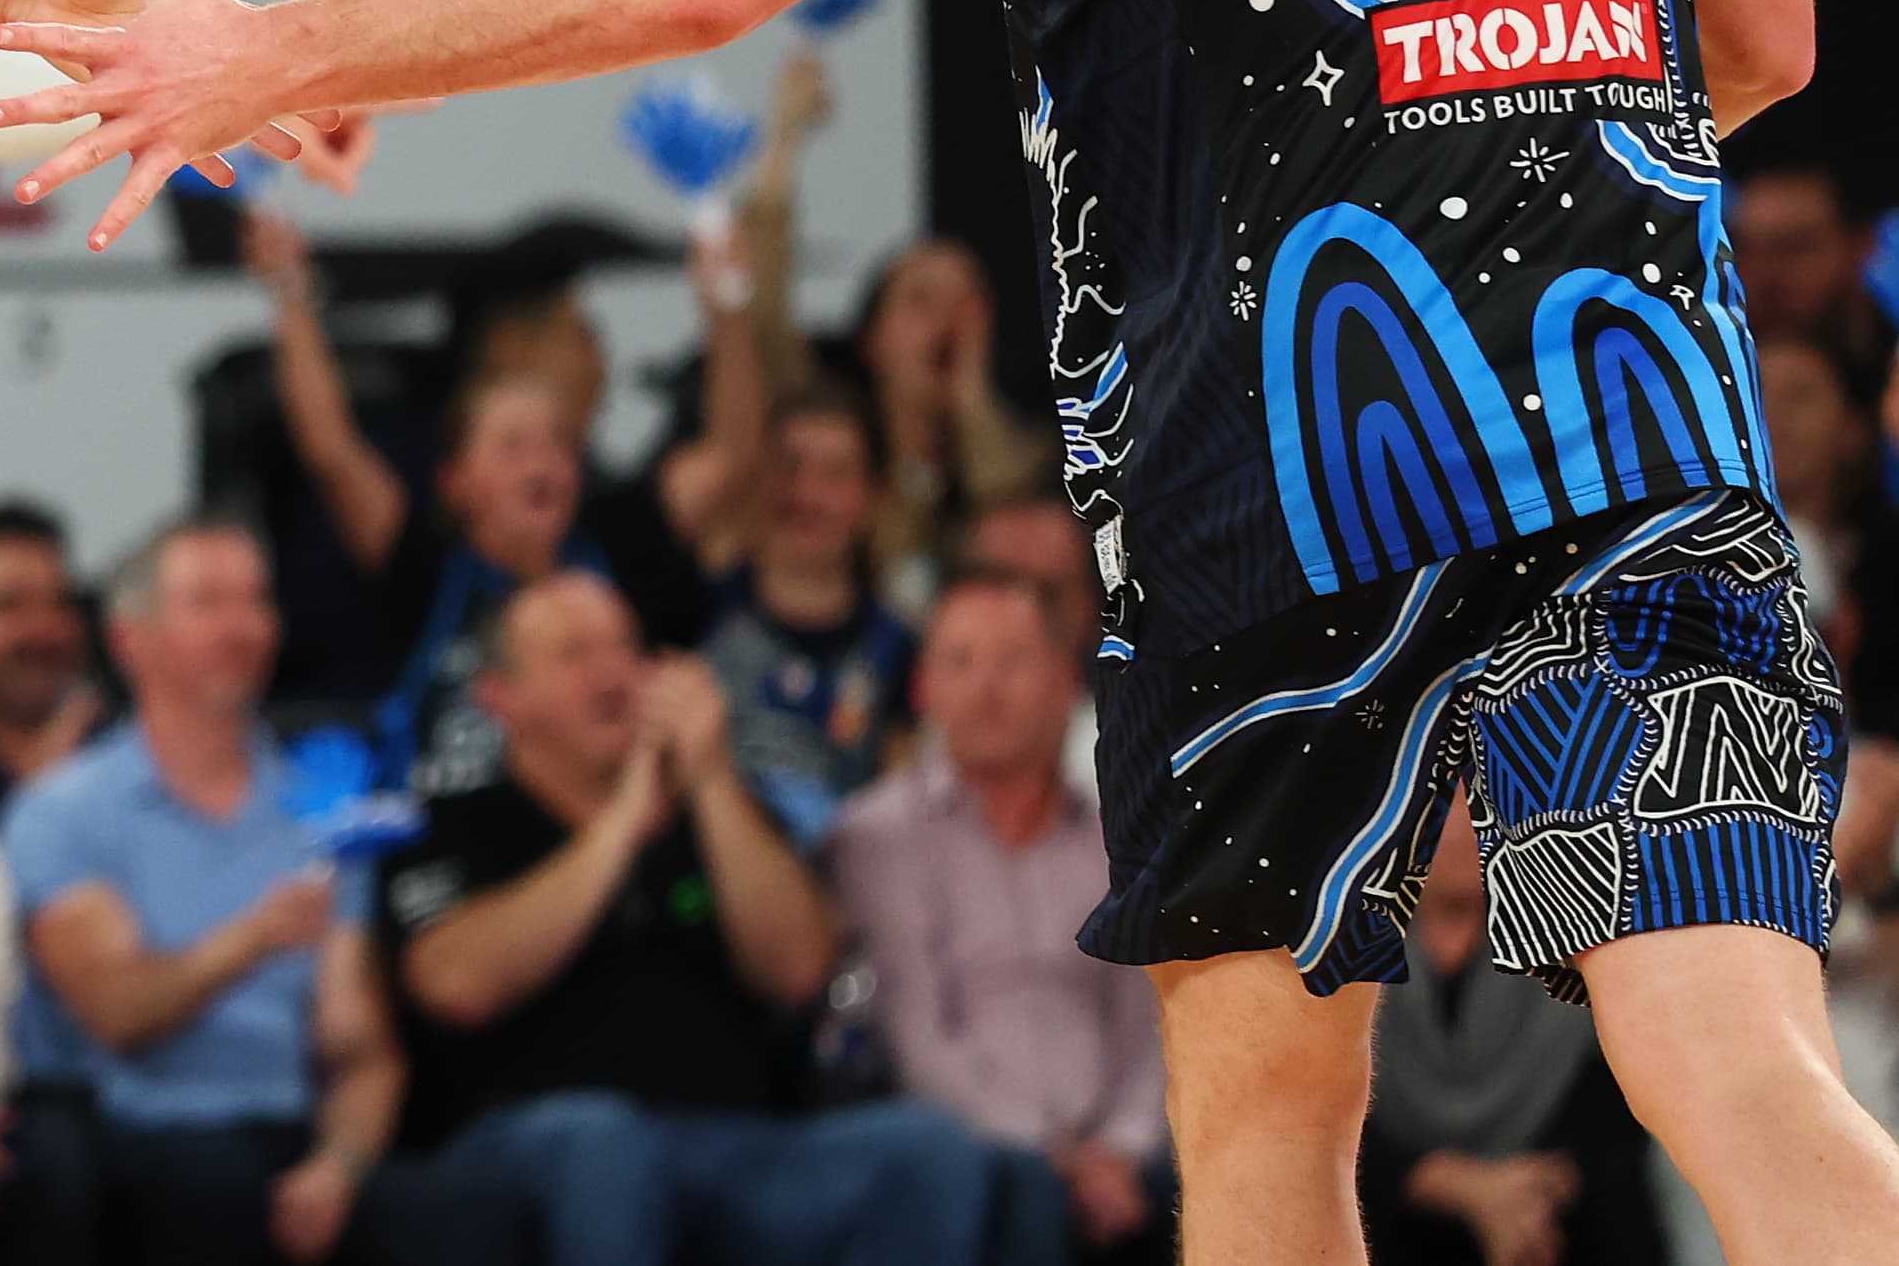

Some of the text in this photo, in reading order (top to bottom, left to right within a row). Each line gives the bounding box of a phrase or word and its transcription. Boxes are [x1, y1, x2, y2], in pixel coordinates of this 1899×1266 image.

[1382, 0, 1648, 84] TROJAN
[1383, 81, 1666, 135] TOOLS BUILT TOUGH
